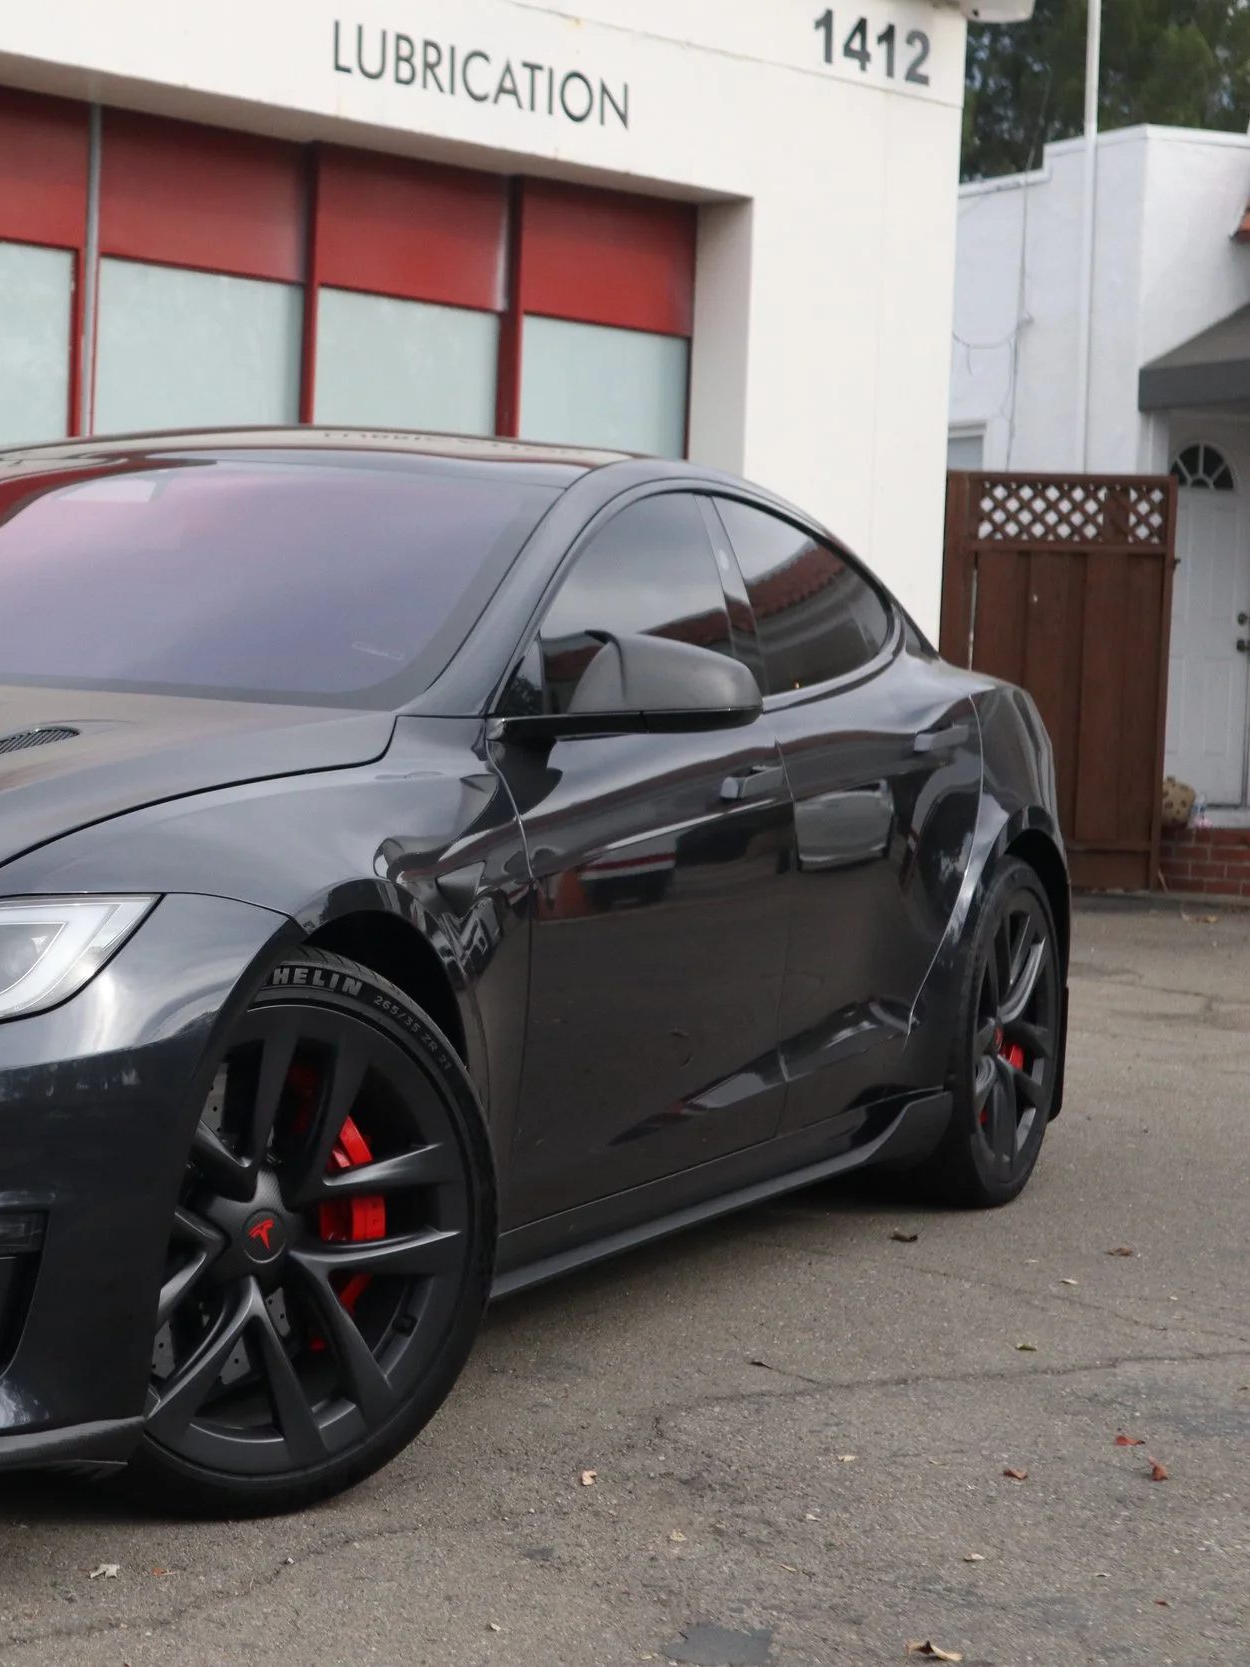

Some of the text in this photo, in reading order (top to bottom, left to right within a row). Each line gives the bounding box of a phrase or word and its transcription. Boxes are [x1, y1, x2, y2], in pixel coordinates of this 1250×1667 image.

[333, 20, 630, 131] LUBRICATION
[813, 8, 931, 87] 1412
[263, 967, 363, 996] HELIN
[373, 995, 421, 1033] 265/35
[421, 1032, 439, 1053] ZR
